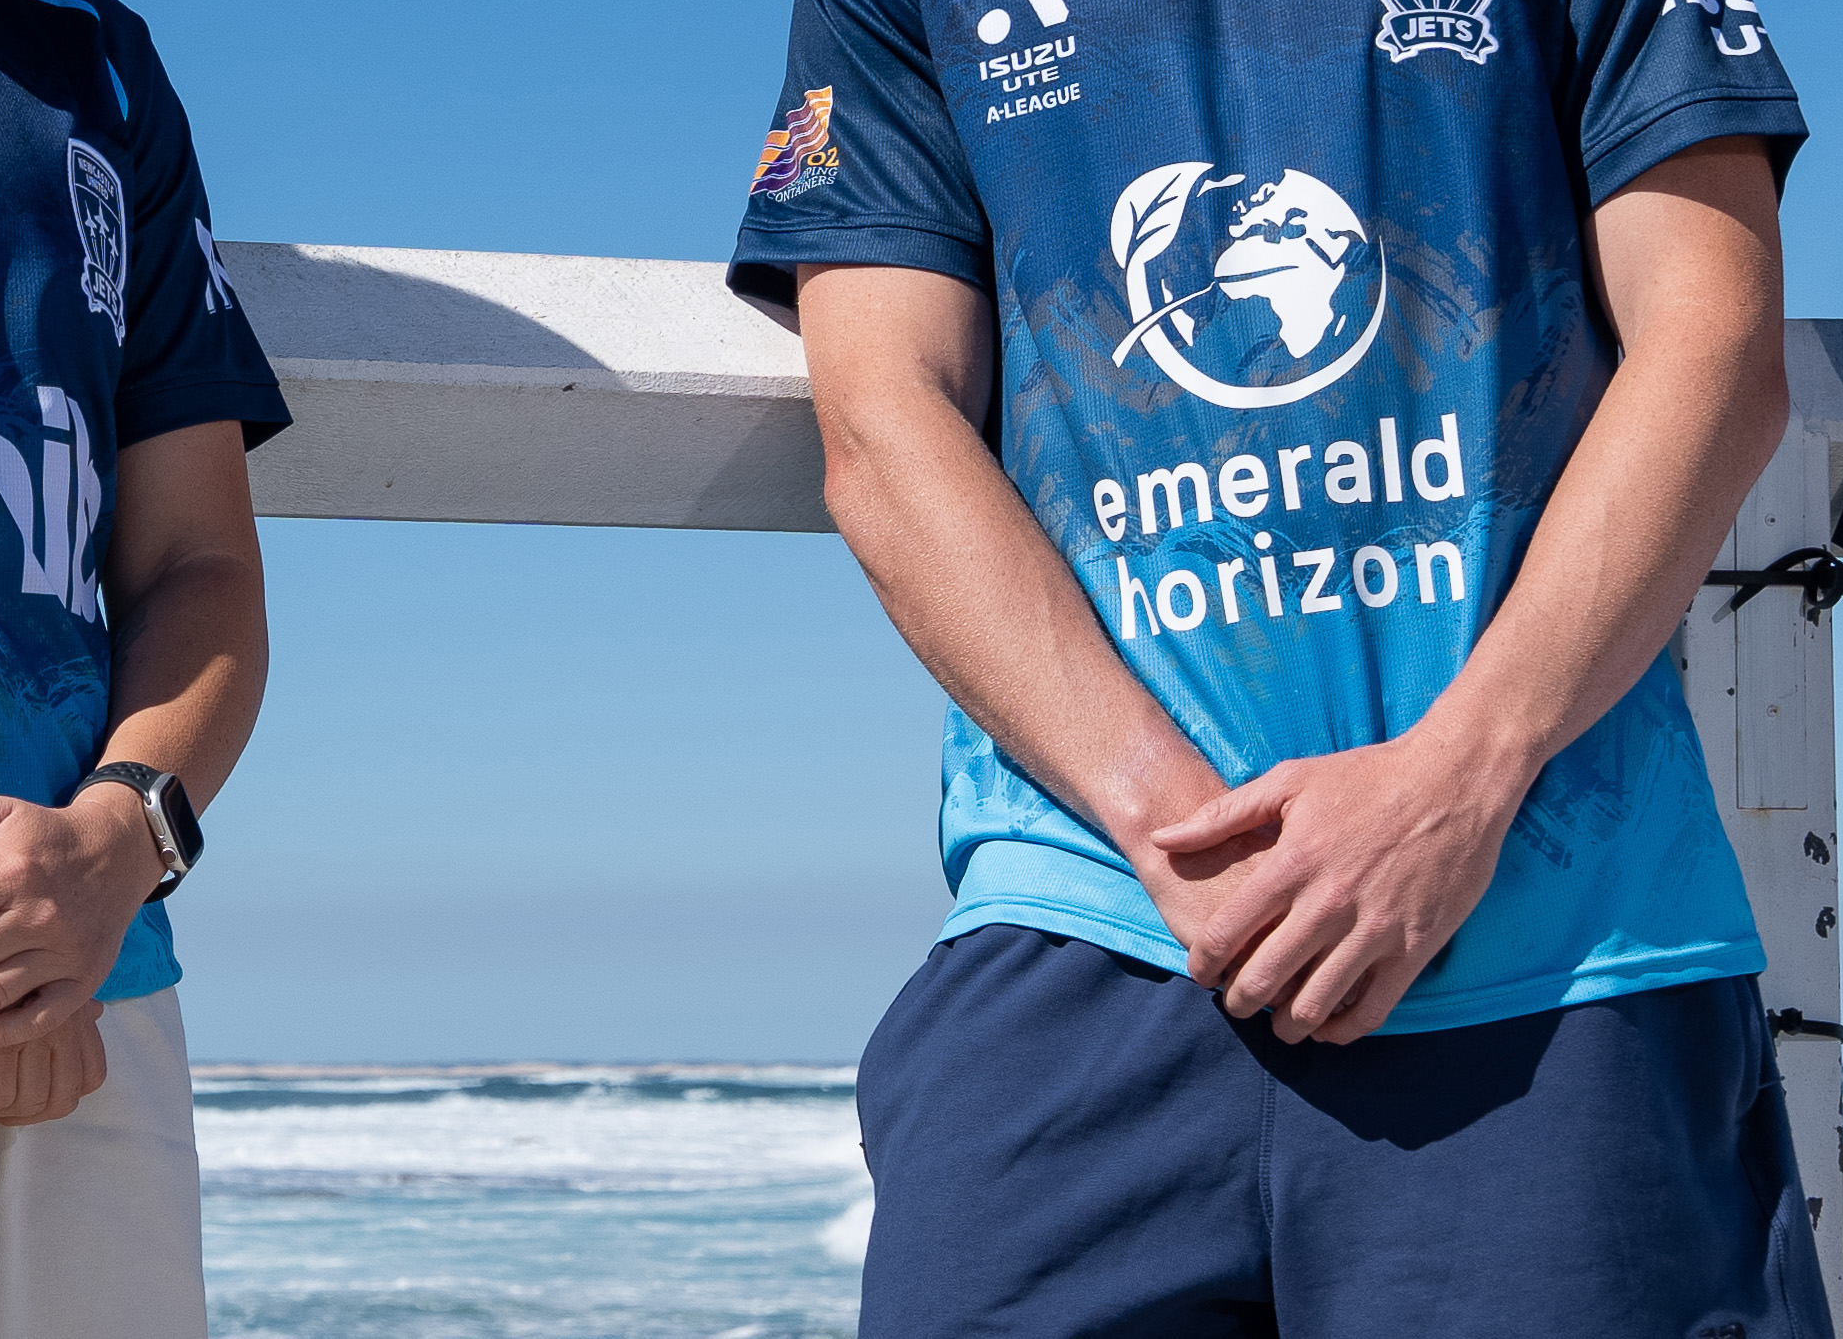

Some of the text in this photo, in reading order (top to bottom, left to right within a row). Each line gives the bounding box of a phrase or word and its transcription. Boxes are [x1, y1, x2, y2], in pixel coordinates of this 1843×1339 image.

[1401, 16, 1473, 42] JETS
[979, 35, 1076, 81] ISUZU
[1002, 65, 1060, 93] UTE
[986, 82, 1081, 124] A-LEAGUE
[807, 146, 839, 167] OZ
[92, 271, 118, 316] JETS
[1092, 412, 1466, 543] emerald
[1115, 531, 1466, 640] horizon
